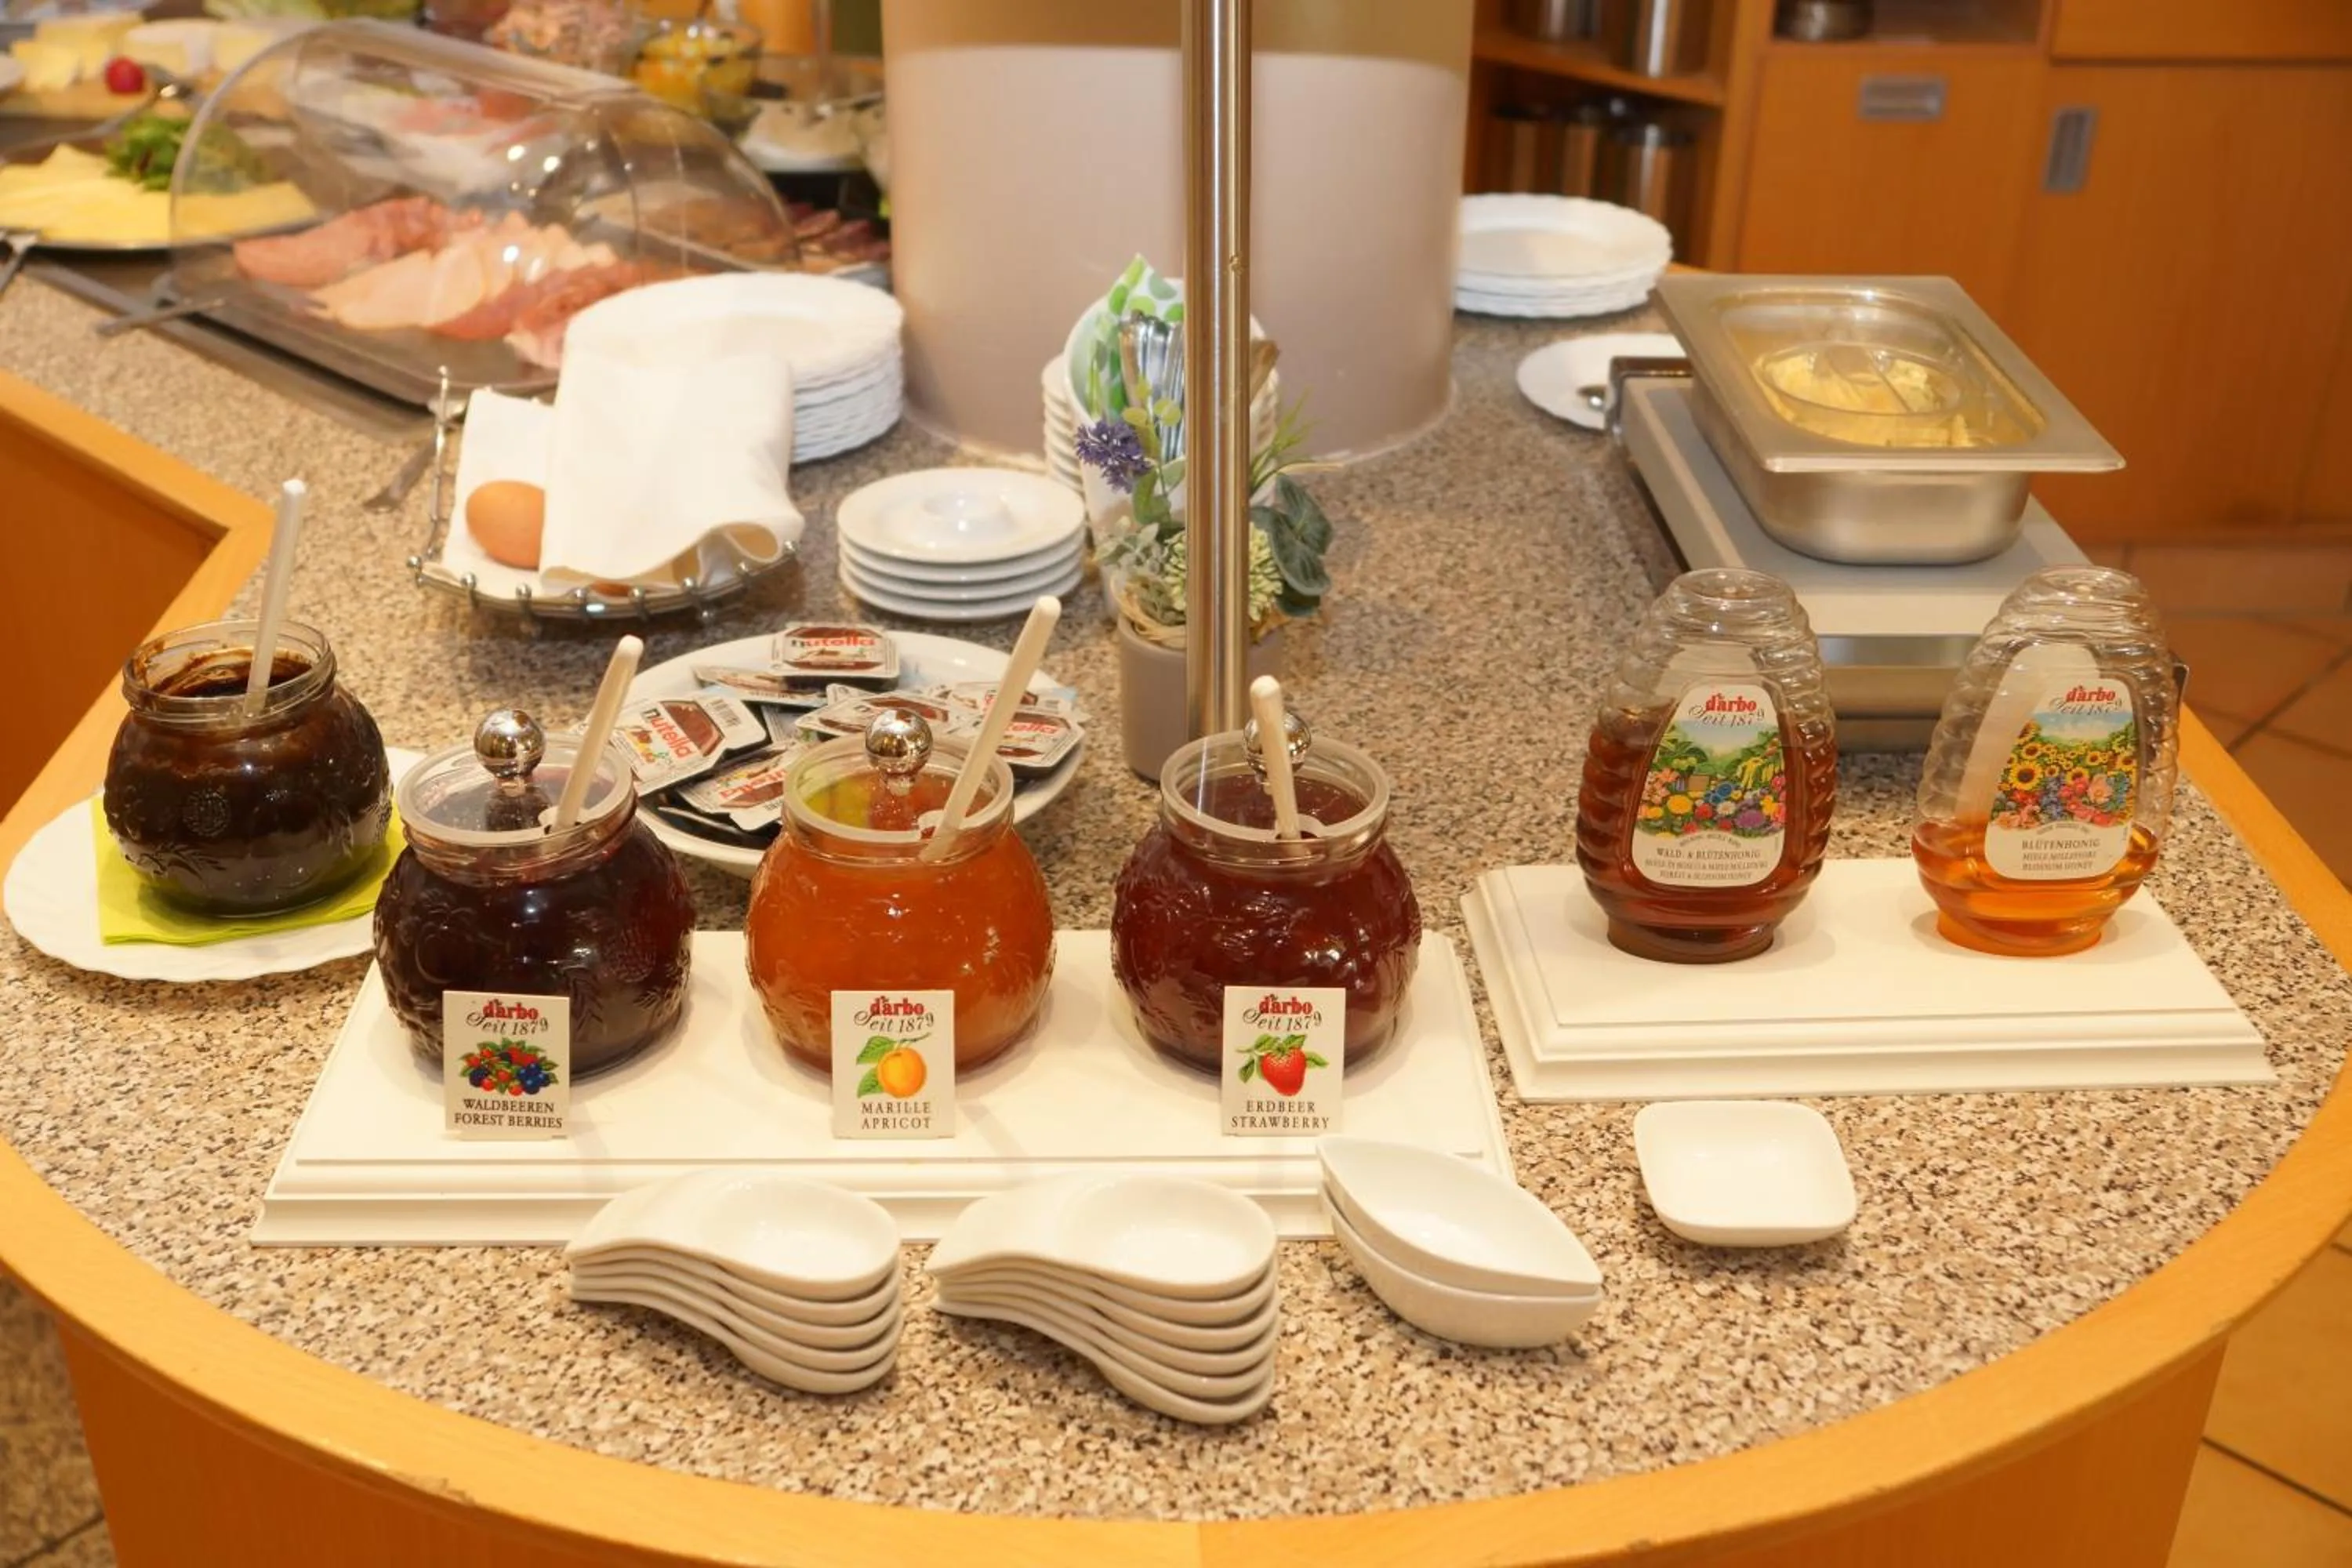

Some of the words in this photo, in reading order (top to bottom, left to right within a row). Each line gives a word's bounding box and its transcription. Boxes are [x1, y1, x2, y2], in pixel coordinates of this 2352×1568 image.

[791, 630, 875, 648] nutella
[641, 708, 691, 758] nutella
[466, 1011, 506, 1034] Seit
[512, 1017, 549, 1036] 1879
[854, 1011, 894, 1033] Seit
[898, 1011, 934, 1033] 1879
[1242, 1008, 1280, 1031] Seit
[1287, 1011, 1323, 1032] 1879
[463, 1098, 554, 1113] WALDBEEREN
[862, 1102, 931, 1113] MARILLE
[1247, 1101, 1316, 1112] ERDBEER
[454, 1113, 505, 1127] FOREST
[508, 1116, 563, 1128] BERRIES
[862, 1117, 931, 1130] APRICOT
[1232, 1116, 1330, 1129] STRAWBERRY
